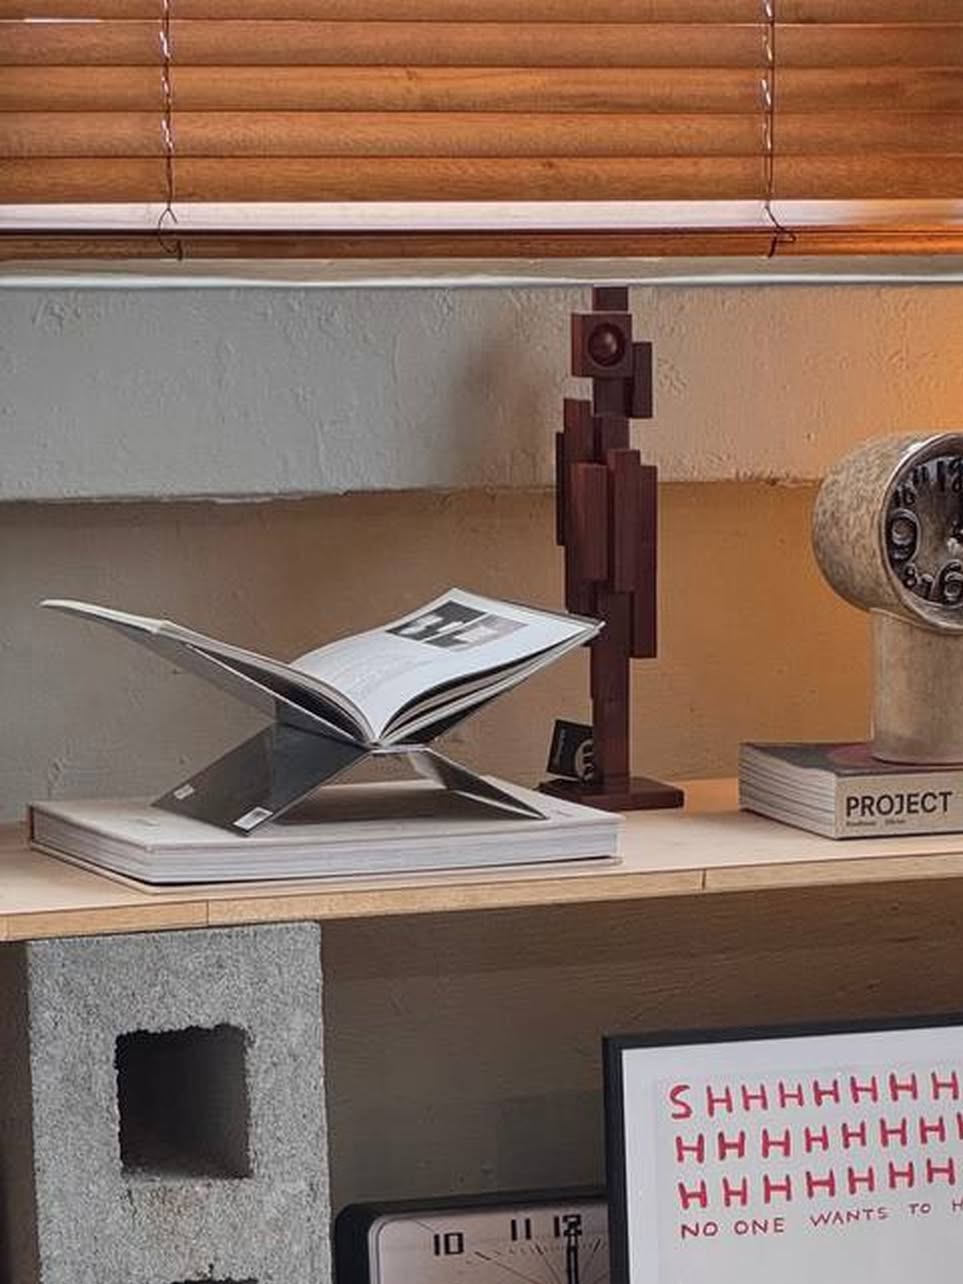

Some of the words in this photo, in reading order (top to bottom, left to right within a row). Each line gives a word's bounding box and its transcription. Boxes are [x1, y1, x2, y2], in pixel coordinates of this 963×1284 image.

[846, 791, 953, 817] PROJECT
[511, 1218, 531, 1241] 11
[554, 1214, 582, 1239] 12
[681, 1222, 718, 1238] NO
[734, 1218, 784, 1235] ONE
[810, 1207, 888, 1226] WANTS
[909, 1203, 931, 1214] TO
[433, 1232, 464, 1256] 10
